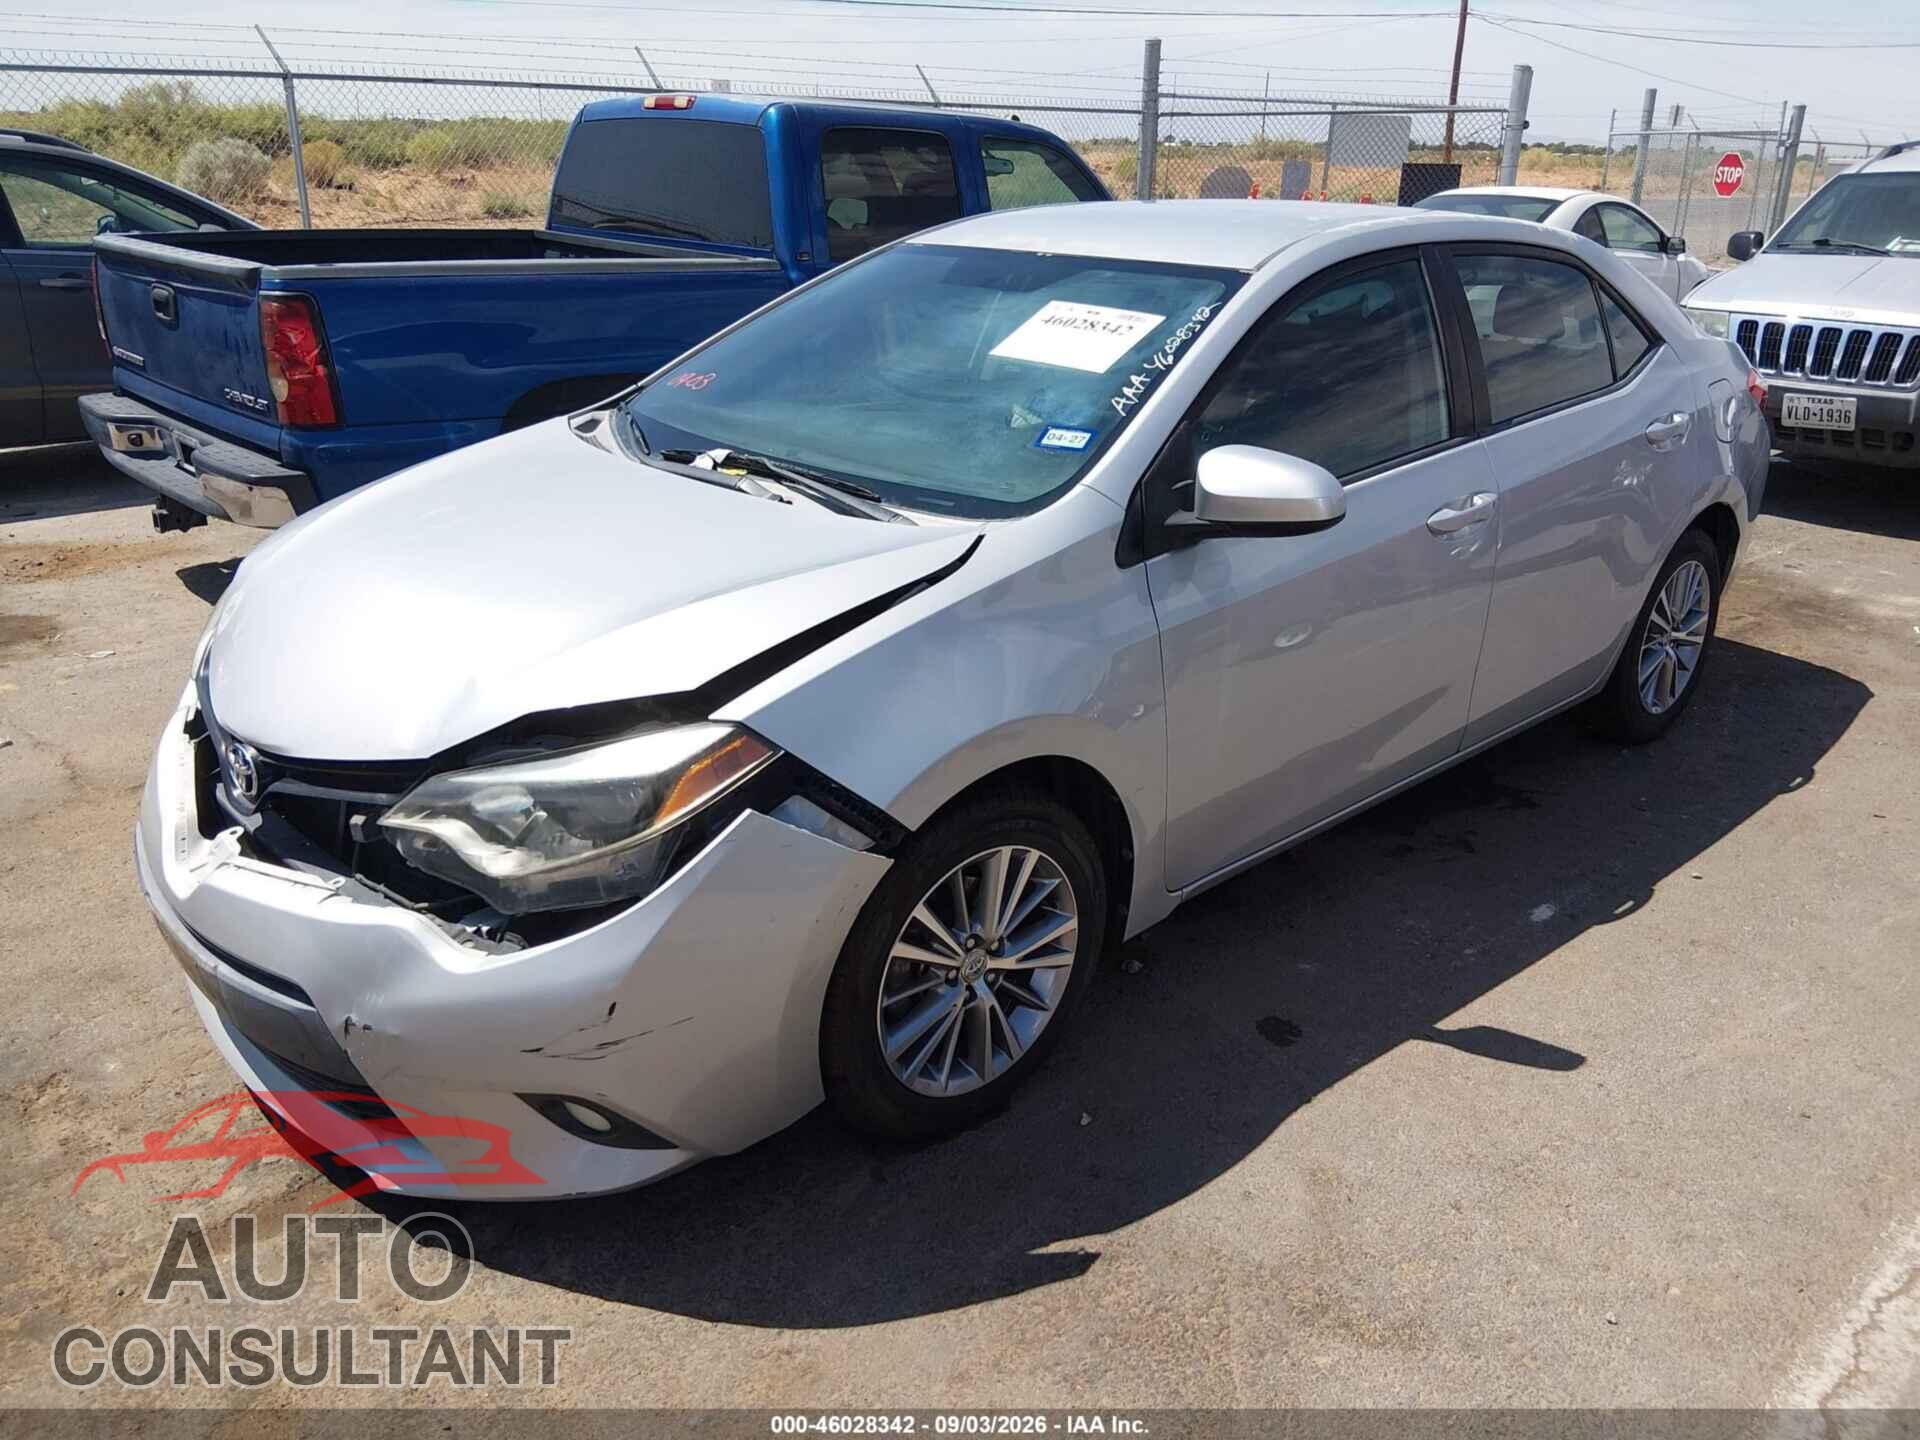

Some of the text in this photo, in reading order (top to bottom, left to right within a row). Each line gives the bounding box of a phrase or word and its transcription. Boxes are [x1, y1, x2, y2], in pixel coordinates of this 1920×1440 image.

[1715, 166, 1742, 184] STOP
[1041, 314, 1134, 336] 46028342
[1111, 373, 1151, 417] AAA
[1143, 302, 1222, 371] 46028342
[1806, 397, 1834, 405] TEXAS
[1047, 431, 1087, 444] 04-27
